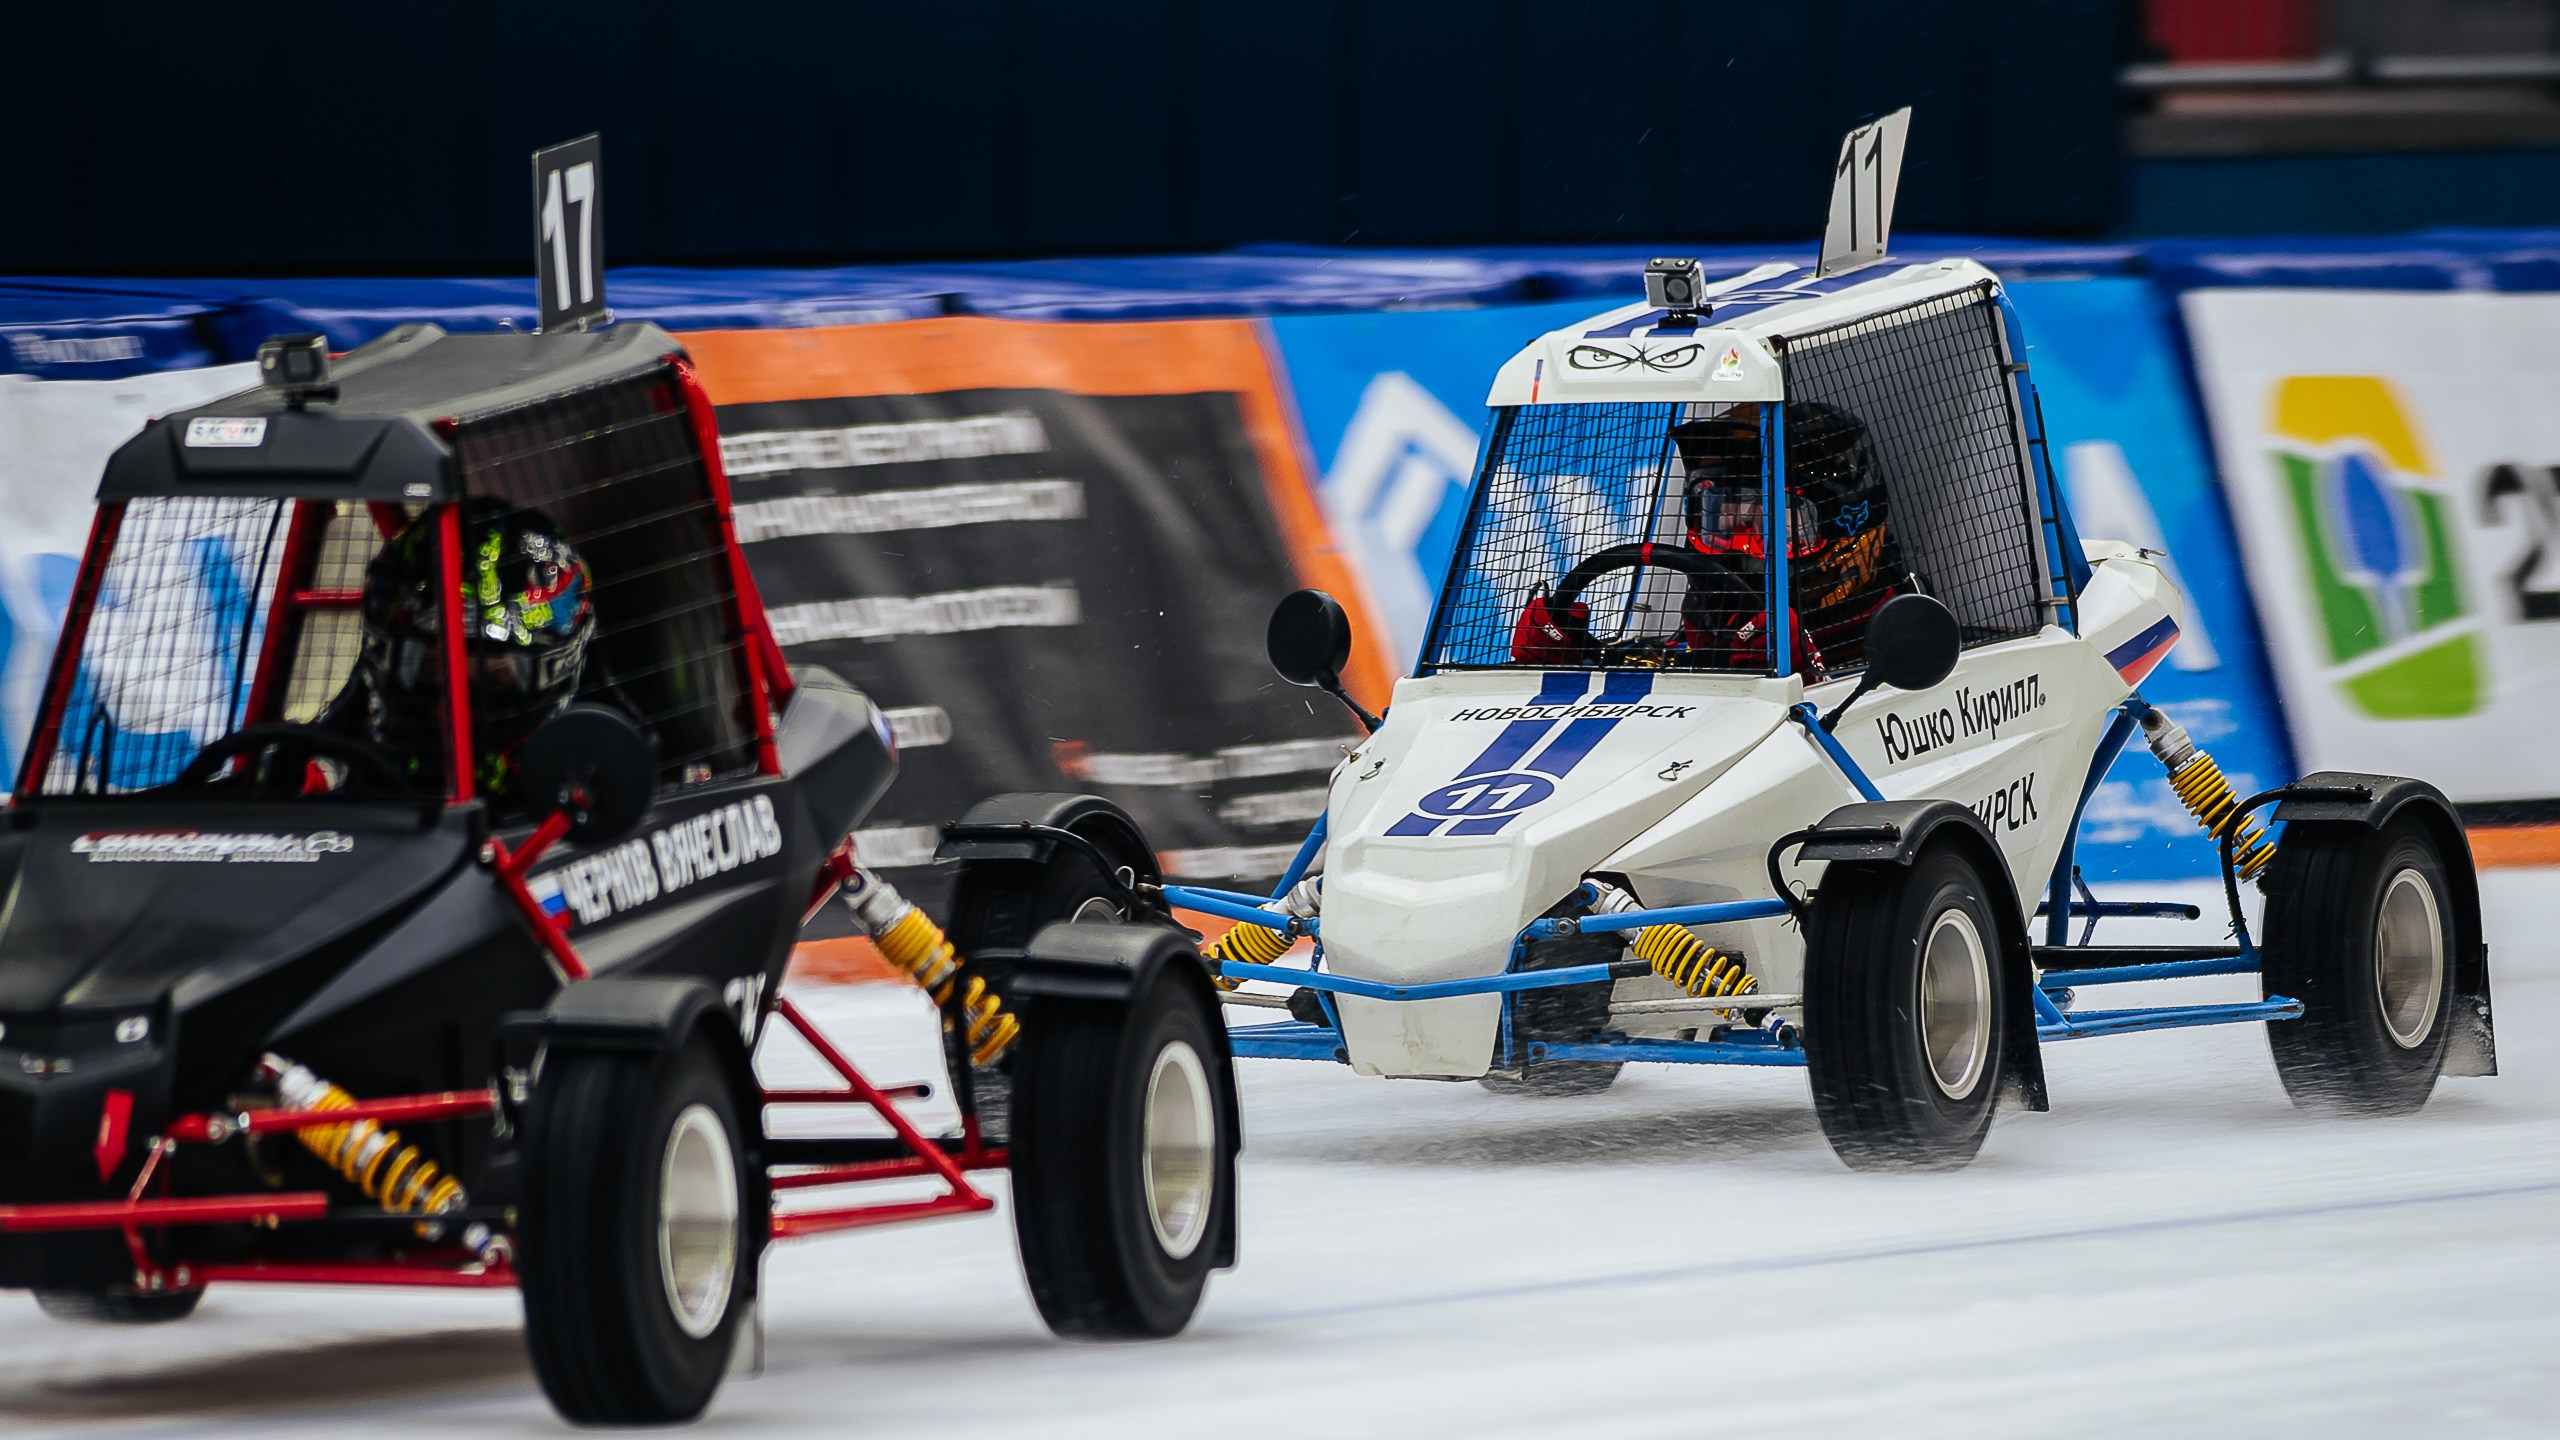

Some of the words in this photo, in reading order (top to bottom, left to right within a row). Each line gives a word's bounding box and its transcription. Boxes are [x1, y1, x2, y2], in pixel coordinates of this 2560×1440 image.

[1838, 126, 1882, 252] 11
[541, 161, 595, 311] 17
[1450, 705, 1697, 722] НОВОСИБИРСК
[1876, 708, 1955, 765] Юшко
[1446, 783, 1534, 810] 11
[1969, 771, 2038, 838] ИРСК
[560, 838, 659, 925] ЧЕРНОВ
[651, 794, 782, 893] ВЯЧЕСЛАВ
